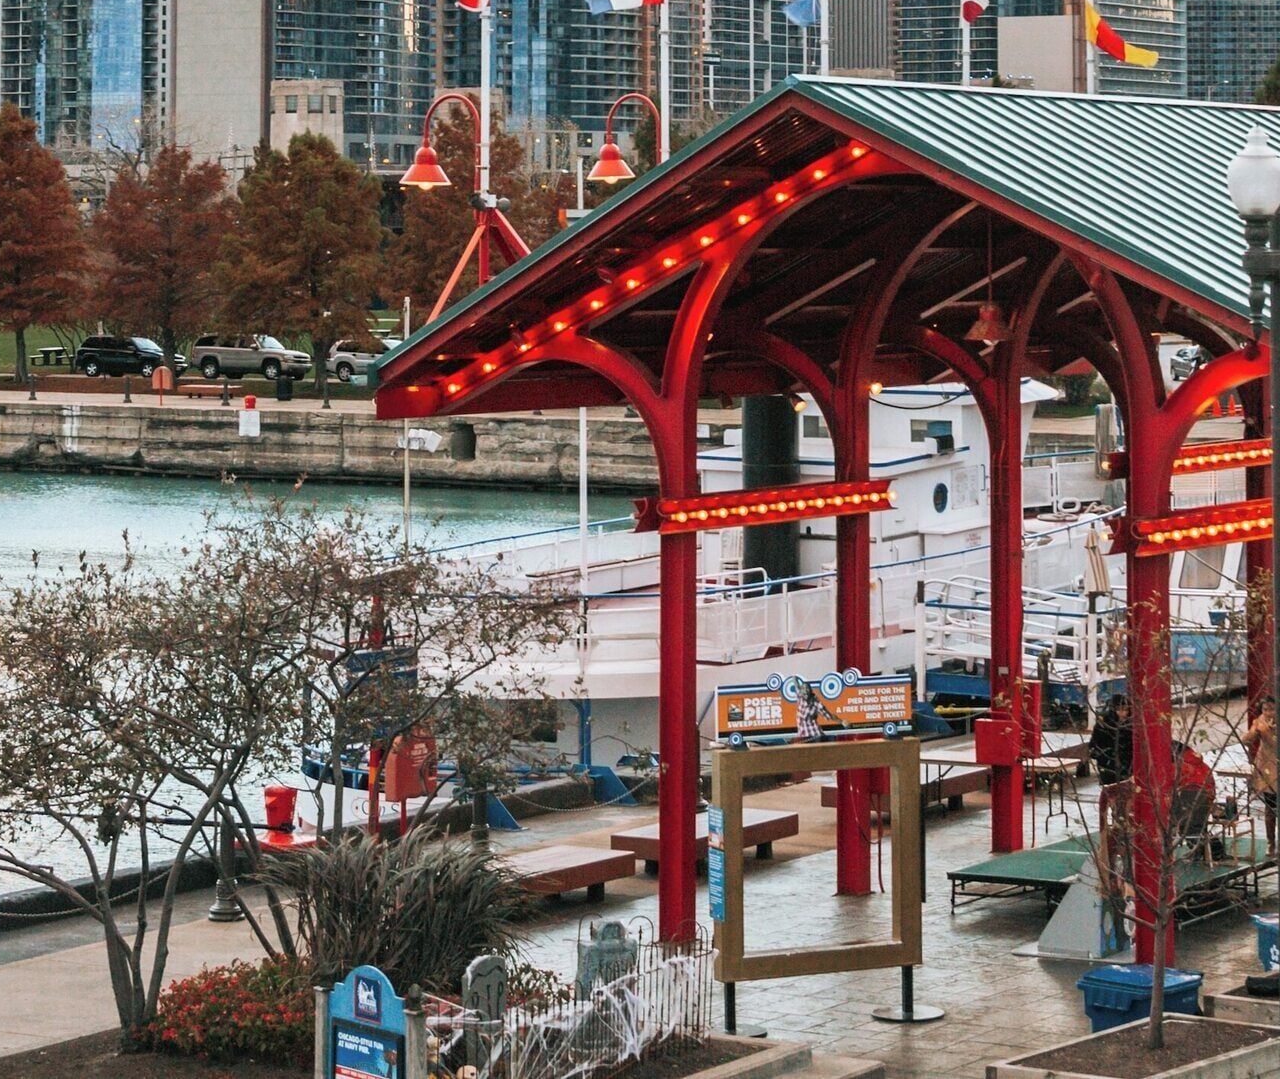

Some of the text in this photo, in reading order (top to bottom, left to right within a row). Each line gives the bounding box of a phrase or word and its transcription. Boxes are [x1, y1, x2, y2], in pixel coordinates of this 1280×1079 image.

[858, 688, 876, 696] POSE
[744, 697, 773, 708] POSE
[864, 695, 879, 703] AND
[880, 694, 906, 702] RECEIVE
[882, 702, 906, 710] WHEEL
[744, 705, 782, 721] PIER
[865, 711, 881, 719] RIDE
[727, 718, 783, 729] SWEEPSTAKES!
